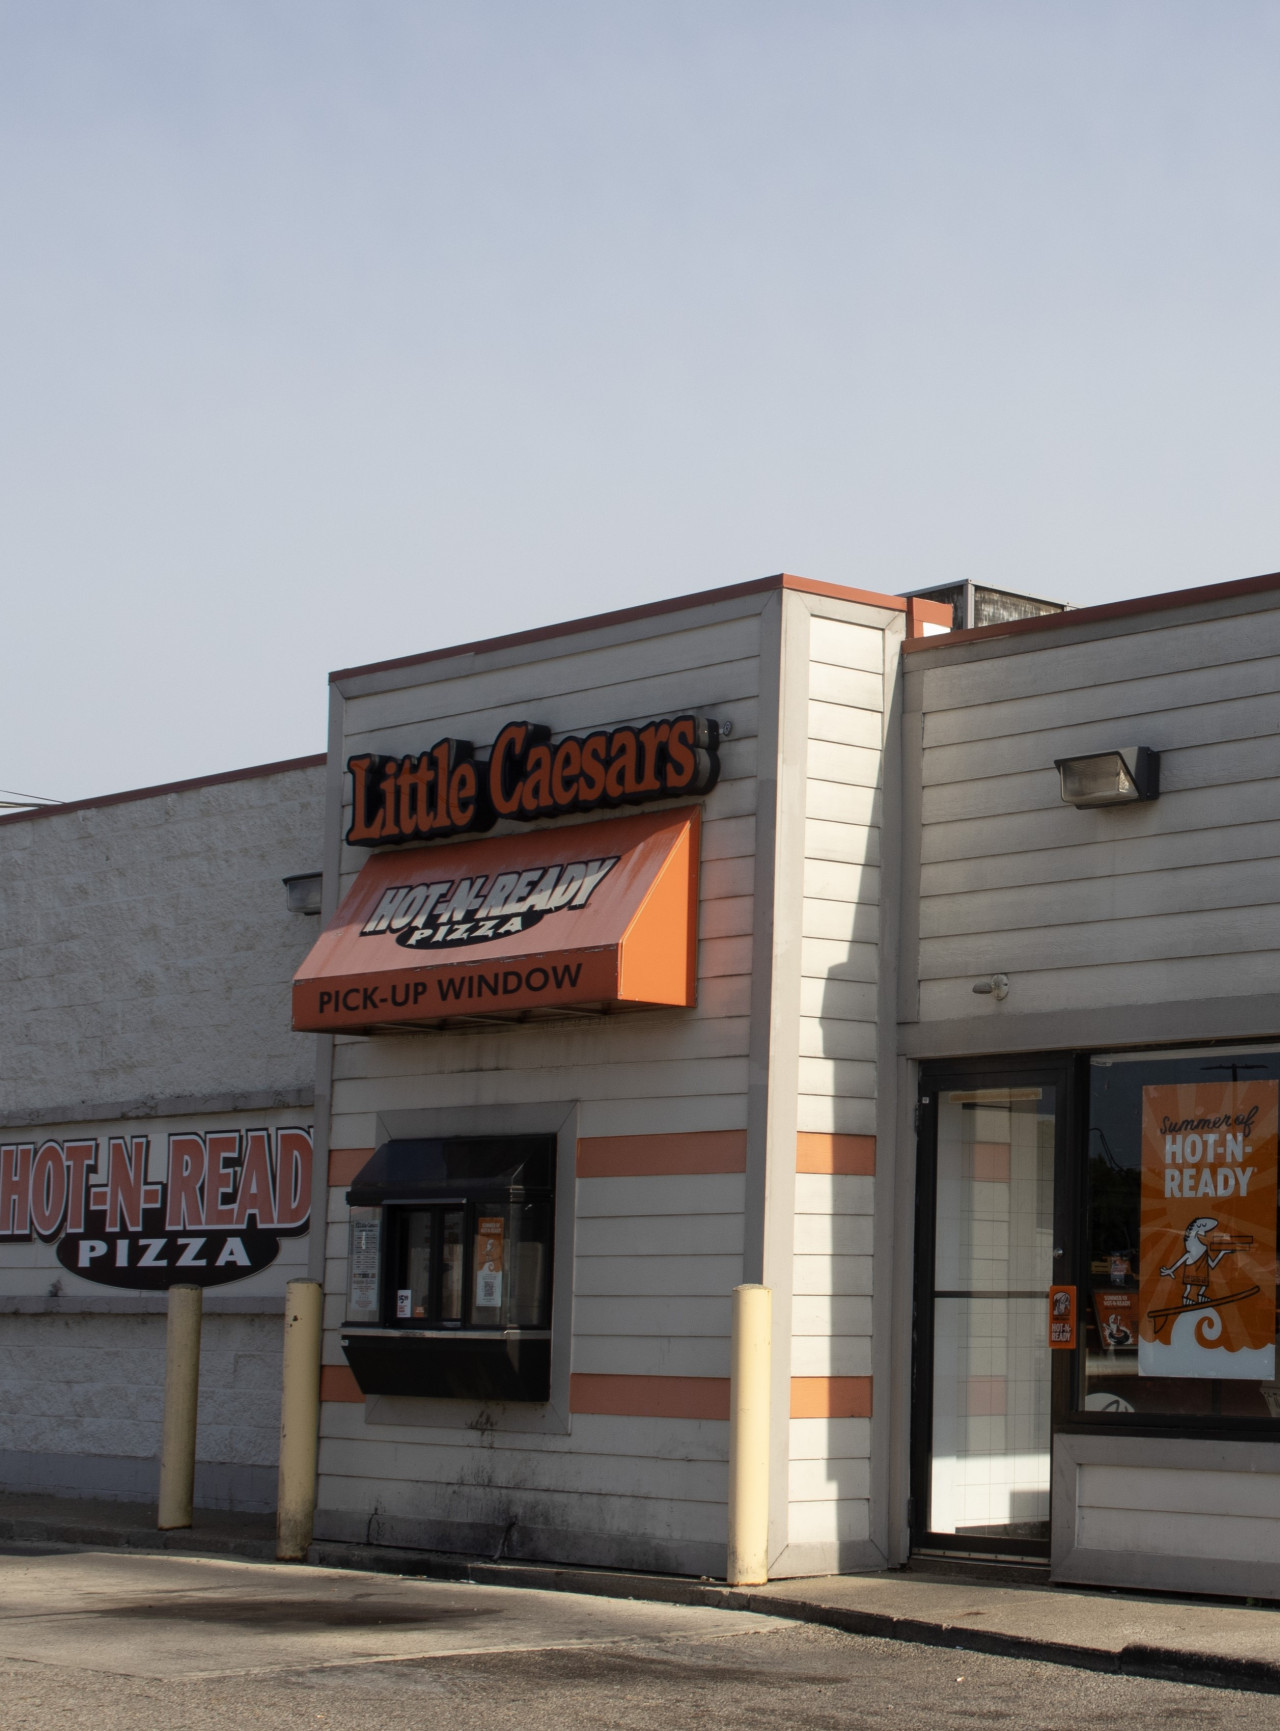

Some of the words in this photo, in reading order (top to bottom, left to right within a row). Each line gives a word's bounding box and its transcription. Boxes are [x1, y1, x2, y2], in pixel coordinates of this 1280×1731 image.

[348, 741, 476, 841] Little
[490, 717, 695, 814] Caesars
[361, 855, 621, 935] HOT-N-READY
[406, 916, 523, 946] PIZZA
[318, 982, 427, 1014] PICK-UP
[437, 964, 583, 1001] WINDOW
[1160, 1115, 1232, 1134] Summer
[1234, 1106, 1259, 1137] of
[1164, 1133, 1253, 1164] HOT-N-
[0, 1127, 313, 1236] HOT-N-READ
[1164, 1167, 1254, 1198] READY
[78, 1237, 252, 1268] PIZZA
[1051, 1332, 1071, 1342] READY
